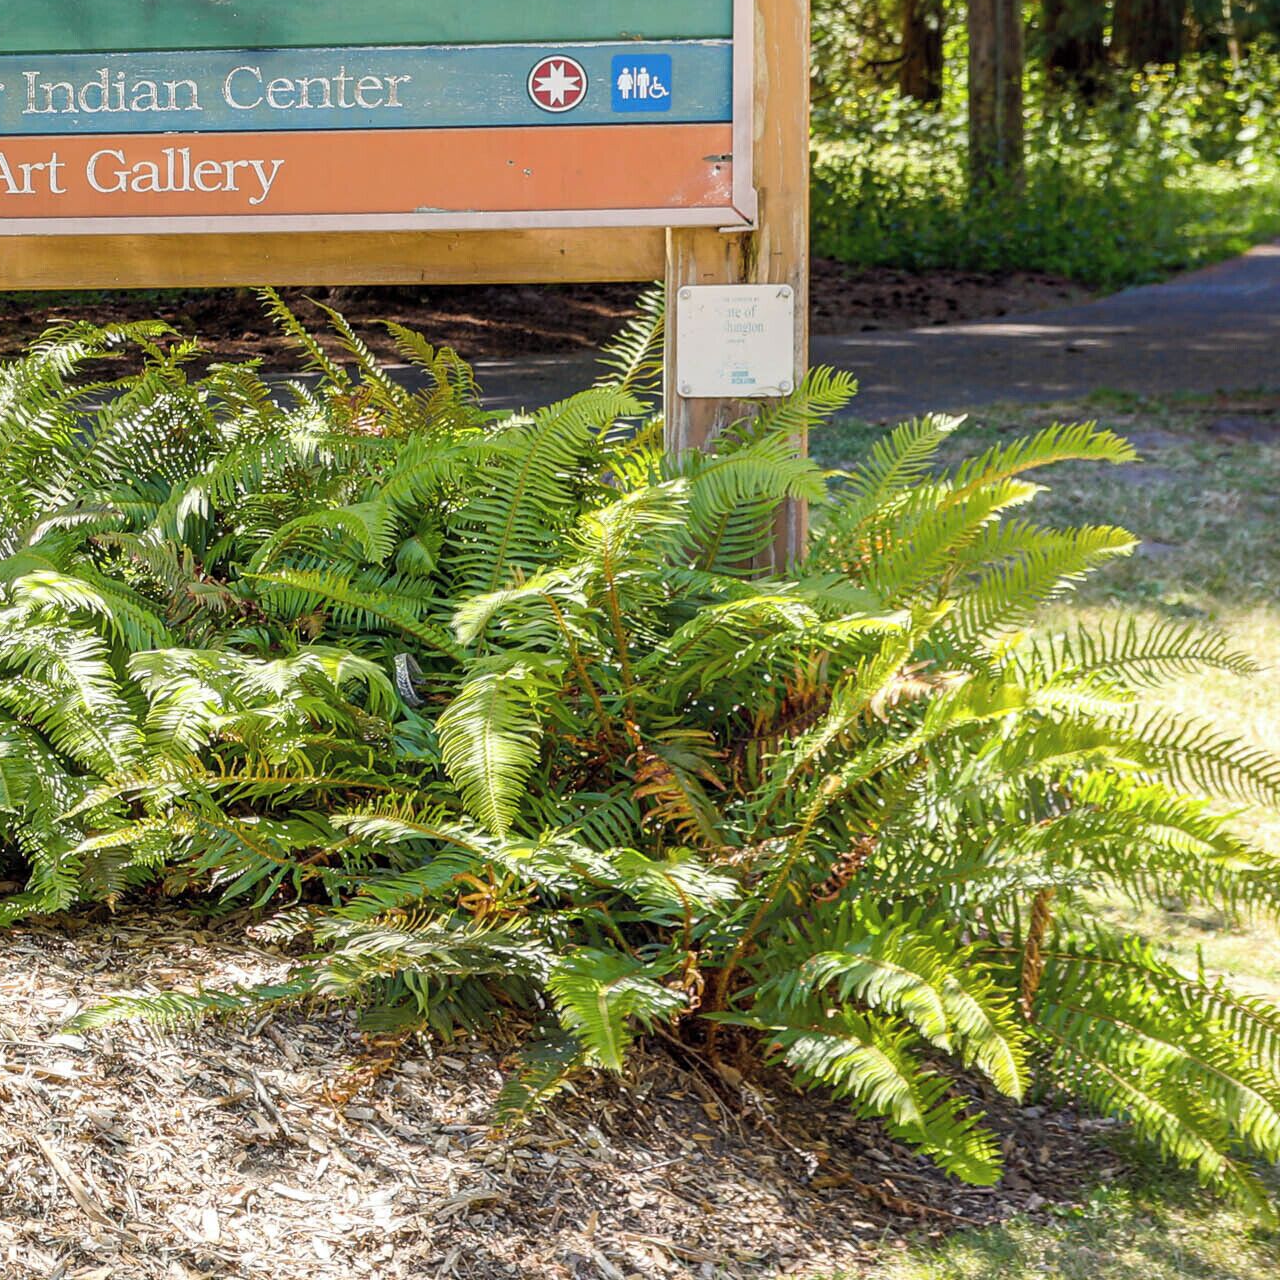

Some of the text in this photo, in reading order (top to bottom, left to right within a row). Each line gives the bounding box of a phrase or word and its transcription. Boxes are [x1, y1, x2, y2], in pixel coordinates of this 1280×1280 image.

[20, 67, 203, 116] Indian
[224, 65, 413, 112] Center
[85, 146, 286, 207] Gallery
